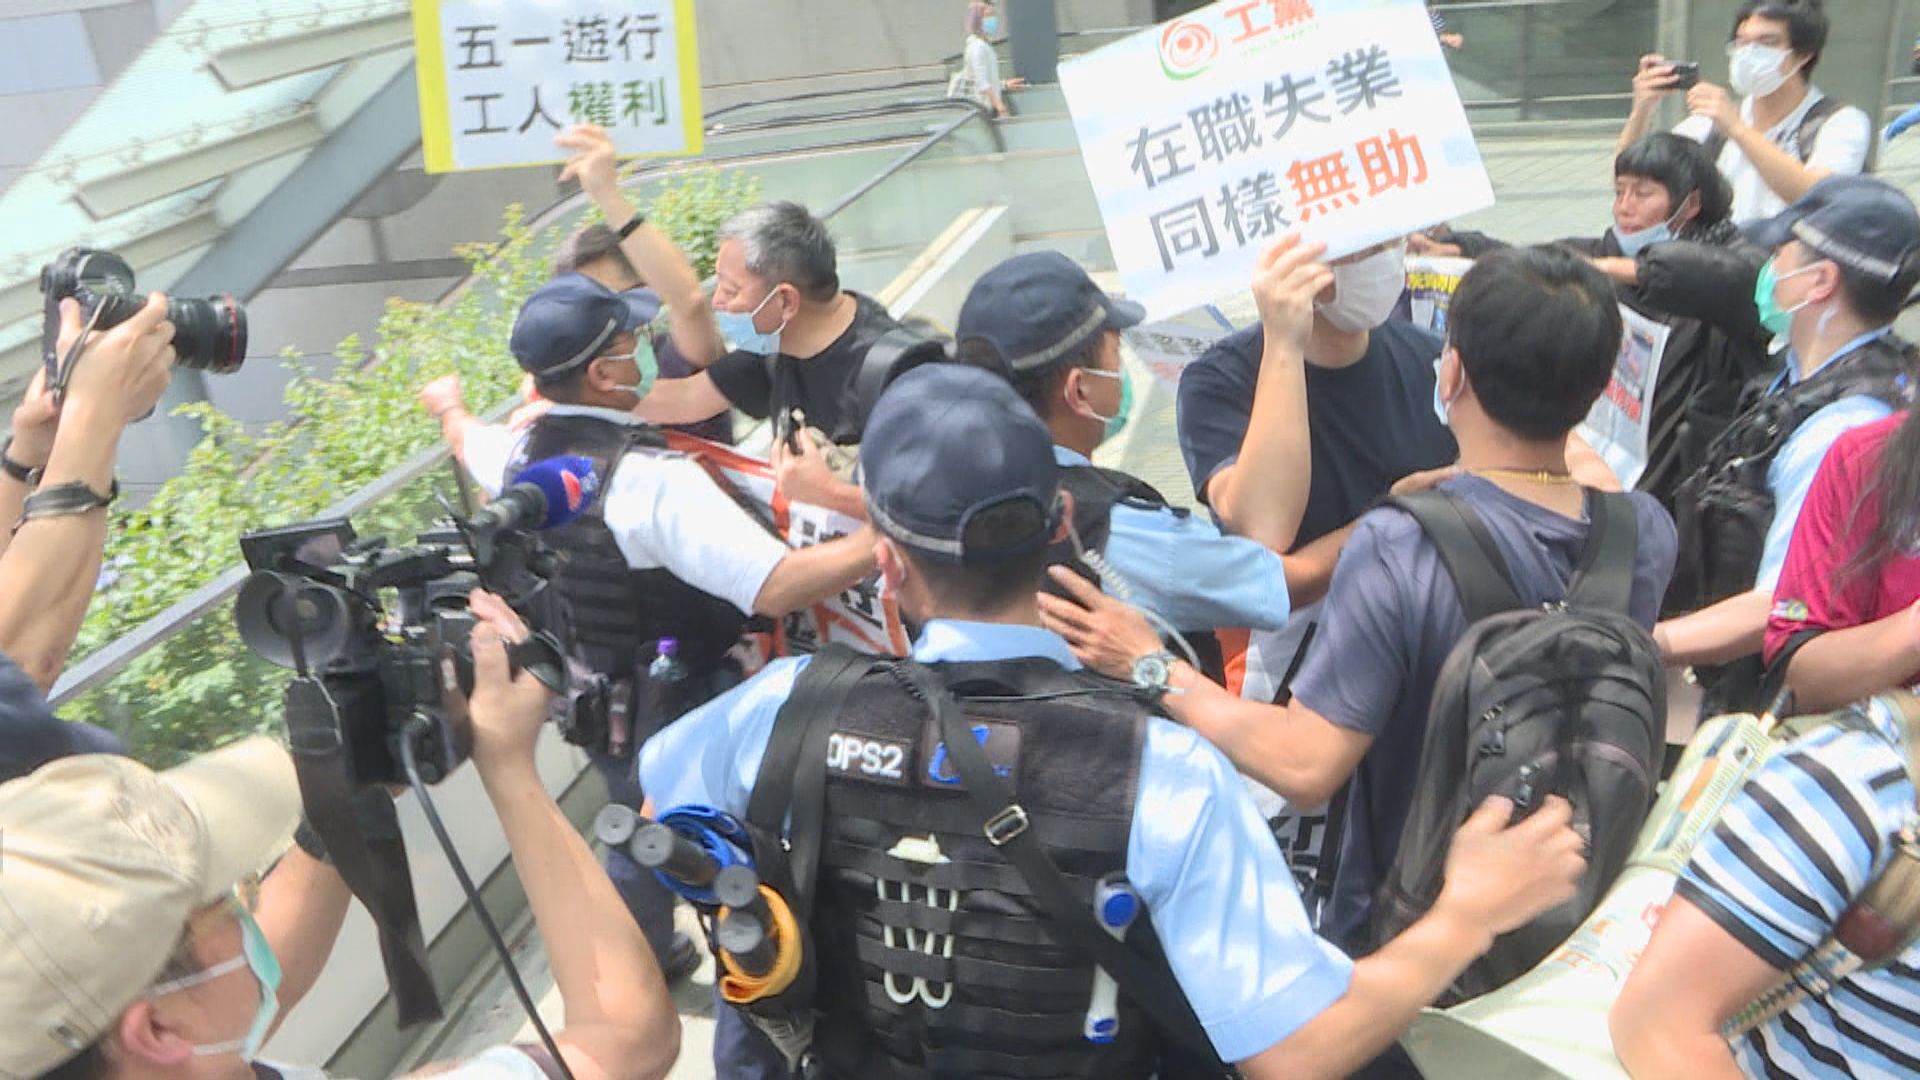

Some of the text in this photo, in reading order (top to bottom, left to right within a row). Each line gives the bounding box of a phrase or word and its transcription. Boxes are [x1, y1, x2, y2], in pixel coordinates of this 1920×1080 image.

[455, 14, 662, 70] 五一遊行
[462, 76, 668, 135] 工人權利
[1126, 44, 1403, 190] 在職失業
[1149, 128, 1428, 272] 同樣無助
